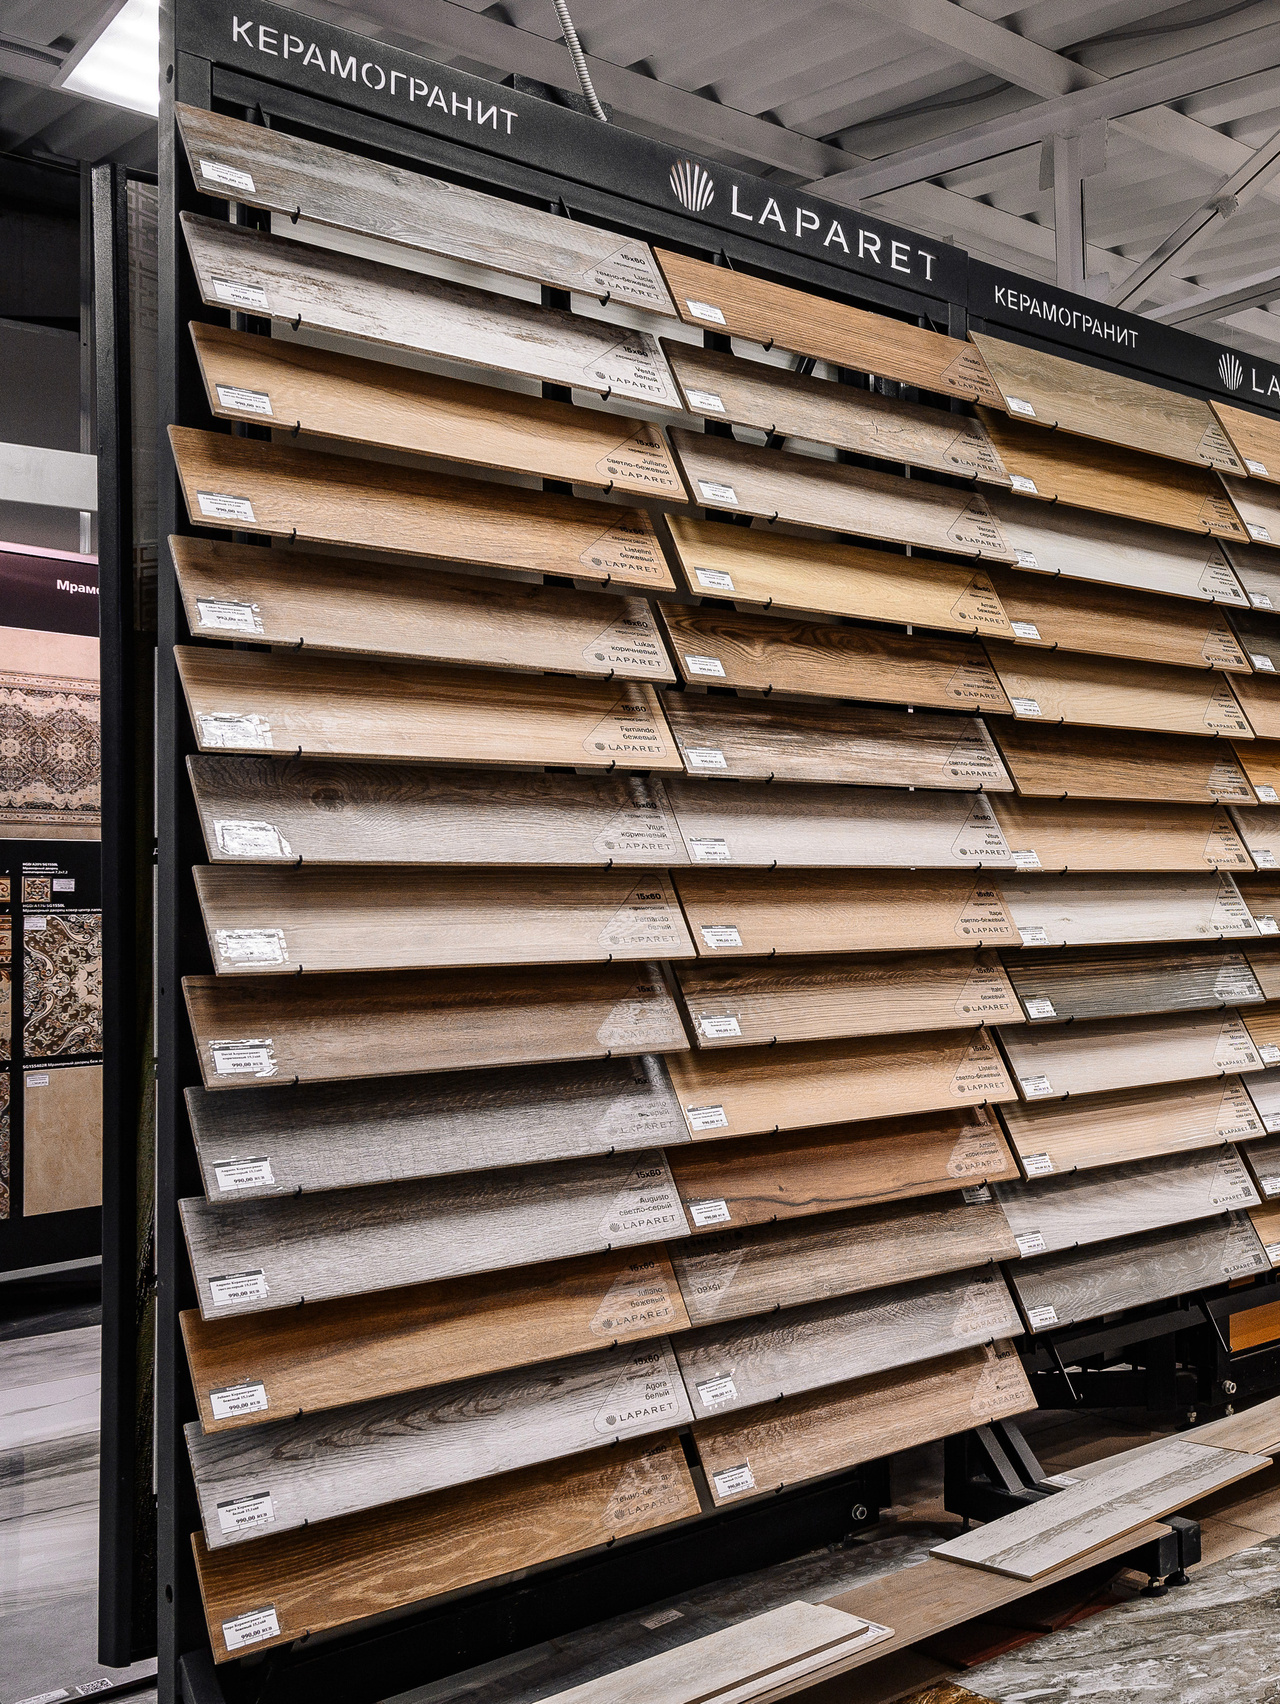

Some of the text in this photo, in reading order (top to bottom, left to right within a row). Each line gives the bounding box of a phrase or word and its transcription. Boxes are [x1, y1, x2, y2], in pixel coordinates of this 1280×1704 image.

[232, 15, 519, 135] КЕРАМОГРАНИТ
[731, 186, 940, 281] LAPARET
[620, 253, 646, 265] 15x60
[608, 282, 660, 299] LAPARET
[995, 285, 1138, 348] КЕРАМОГРАНИТ
[623, 346, 648, 357] 15x60
[609, 375, 661, 393] LAPARET
[957, 381, 995, 396] LAPARET
[635, 438, 661, 450] 15x60
[642, 458, 668, 469] Juliano
[960, 459, 998, 472] LAPARET
[621, 470, 673, 486] LAPARET
[619, 526, 644, 536] 15x60
[964, 536, 1001, 549] LAPARET
[624, 546, 652, 555] Listelini
[620, 552, 655, 563] бежевый
[605, 560, 658, 574] LAPARET
[622, 619, 648, 629] 15x60
[968, 614, 1005, 625] LAPARET
[611, 645, 658, 656] коричневый
[633, 641, 655, 649] Lukas
[608, 655, 661, 667] LAPARET
[963, 690, 1001, 700] LAPARET
[621, 704, 646, 713] 15x60
[620, 726, 655, 734] Fernando
[623, 733, 658, 742] бежевый
[608, 744, 661, 753] LAPARET
[960, 769, 997, 777] LAPARET
[632, 801, 657, 809] 15x60
[617, 842, 671, 851] LAPARET
[636, 893, 661, 901] 15x60
[635, 915, 669, 923] Fernando
[648, 922, 672, 930] белый
[971, 926, 1010, 934] LAPARET
[622, 935, 676, 944] LAPARET
[971, 1004, 1010, 1012] LAPARET
[967, 1082, 1005, 1091] LAPARET
[964, 1159, 1003, 1170] LAPARET
[636, 1169, 662, 1179] 15x60
[233, 1176, 254, 1184] 990,00
[639, 1193, 669, 1204] Augusto
[1218, 1193, 1243, 1204] LAPARET
[619, 1202, 672, 1216] светло-серый
[623, 1214, 676, 1229] LAPARET
[629, 1261, 655, 1272] 15x60
[228, 1291, 248, 1299] 990,00
[637, 1287, 663, 1297] Juliano
[616, 1307, 669, 1326] LAPARET
[633, 1354, 660, 1366] 15x60
[645, 1381, 667, 1392] Agora
[645, 1389, 670, 1400] белый
[228, 1402, 249, 1411] 990,00
[619, 1402, 673, 1422] LAPARET
[235, 1515, 256, 1524] 990,00
[241, 1630, 261, 1640] 990,00
